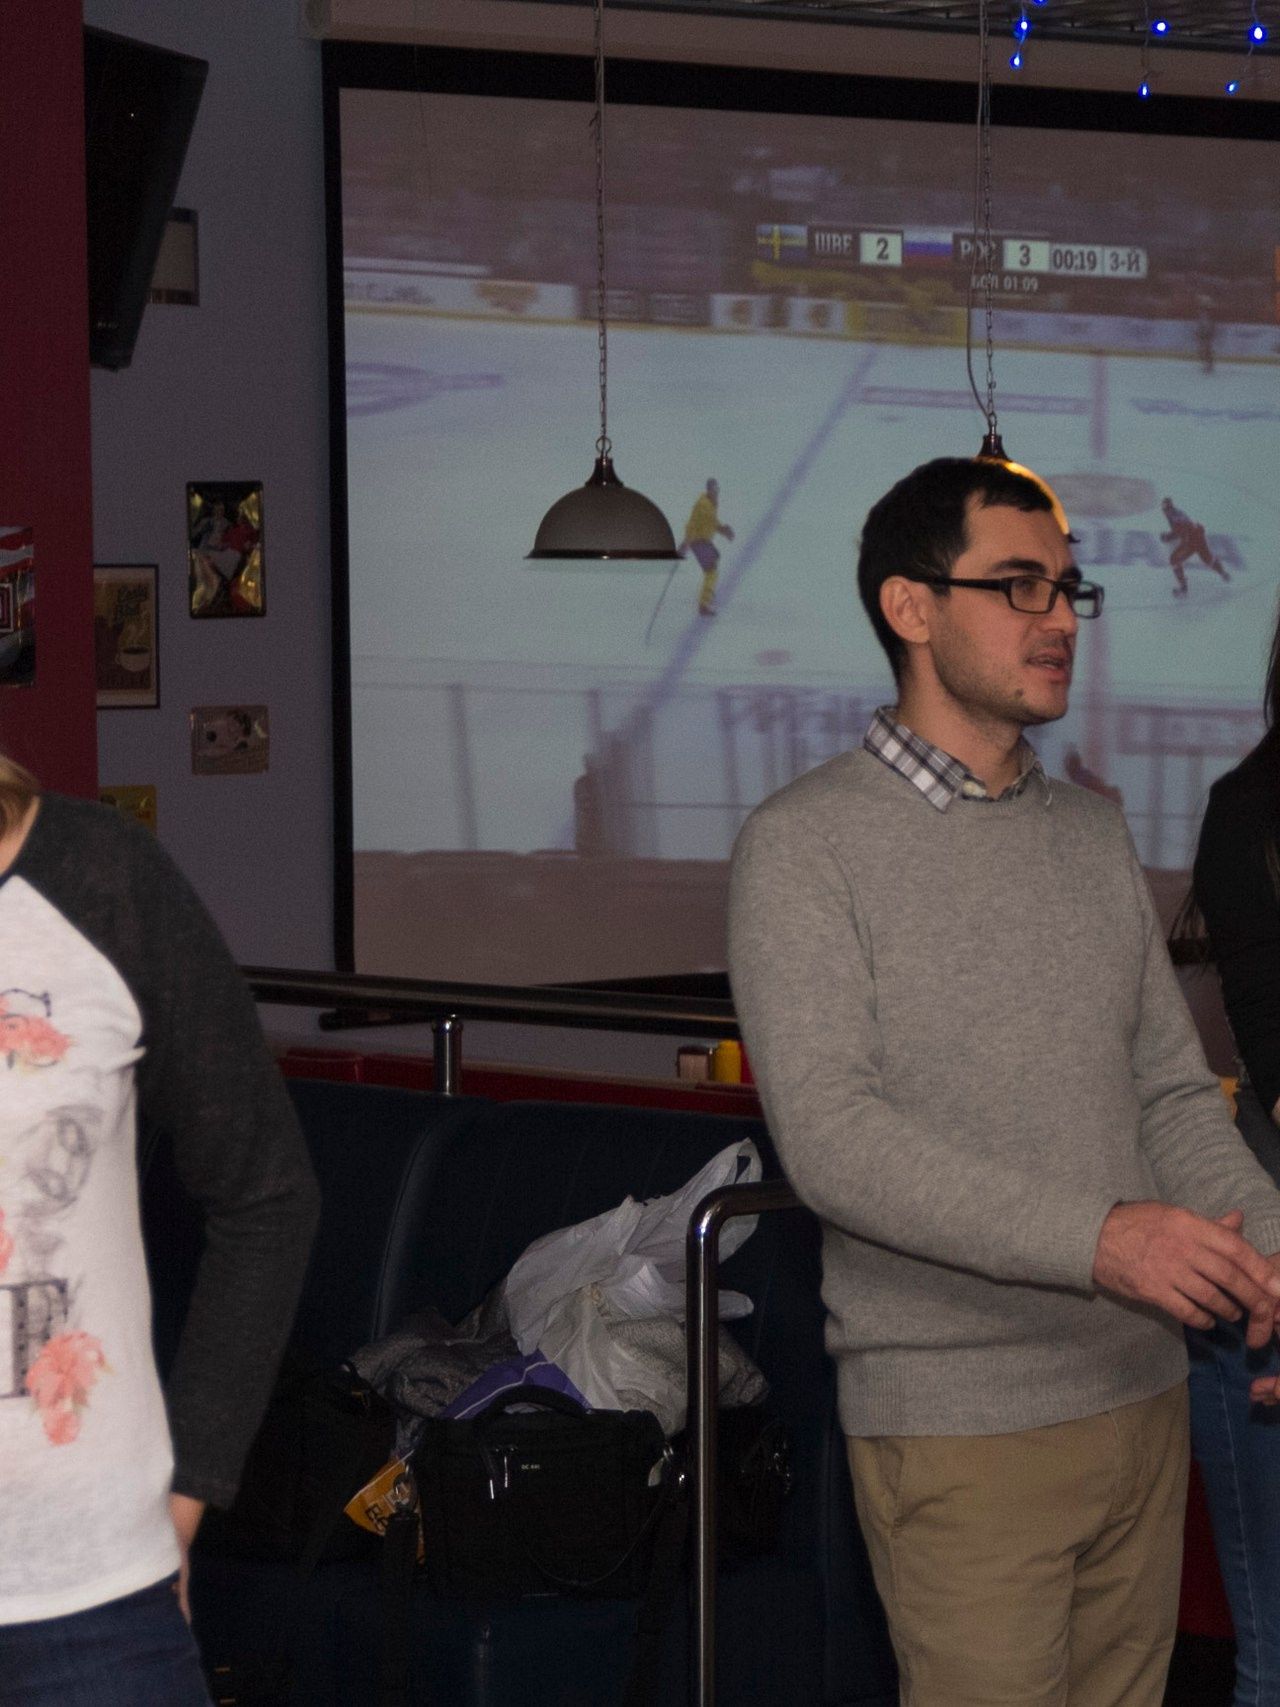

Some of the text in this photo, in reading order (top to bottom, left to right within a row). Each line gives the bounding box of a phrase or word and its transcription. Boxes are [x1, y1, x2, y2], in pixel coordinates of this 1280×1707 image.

[814, 231, 854, 256] ШВЕ
[875, 237, 890, 261] 2
[1018, 243, 1031, 268] 3
[1052, 248, 1097, 272] 00:19
